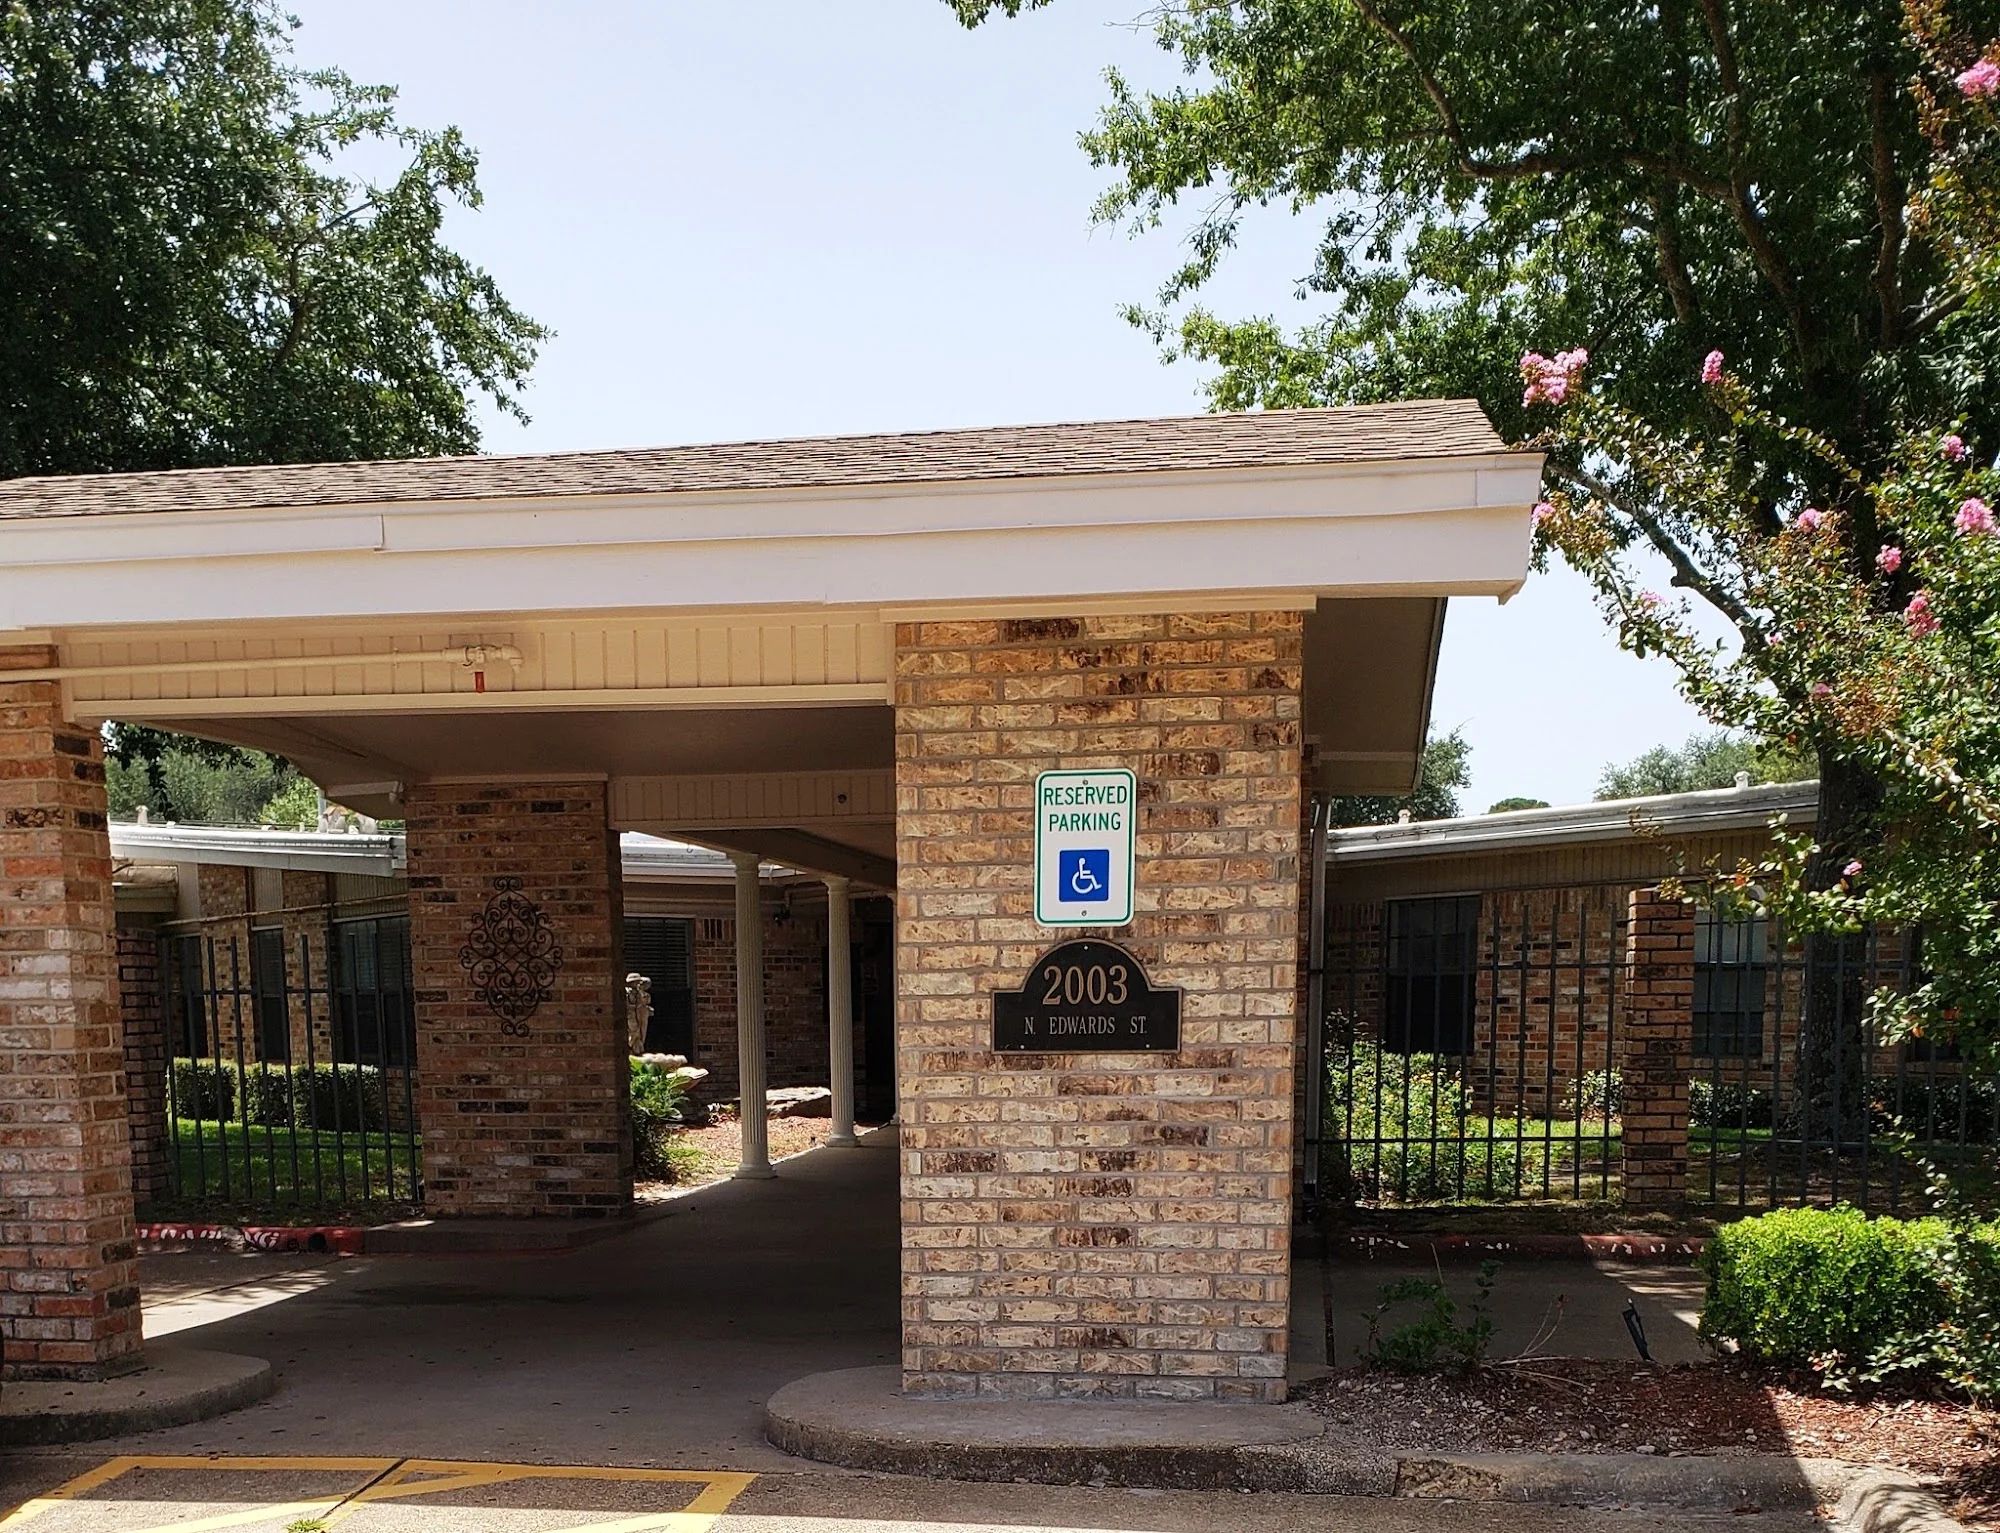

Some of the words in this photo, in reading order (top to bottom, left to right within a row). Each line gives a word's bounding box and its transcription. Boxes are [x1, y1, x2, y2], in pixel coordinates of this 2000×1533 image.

[1043, 785, 1128, 806] RESERVED
[1048, 812, 1121, 832] PARKING
[1042, 964, 1128, 1006] 2003
[1048, 1016, 1116, 1035] EDWARDS
